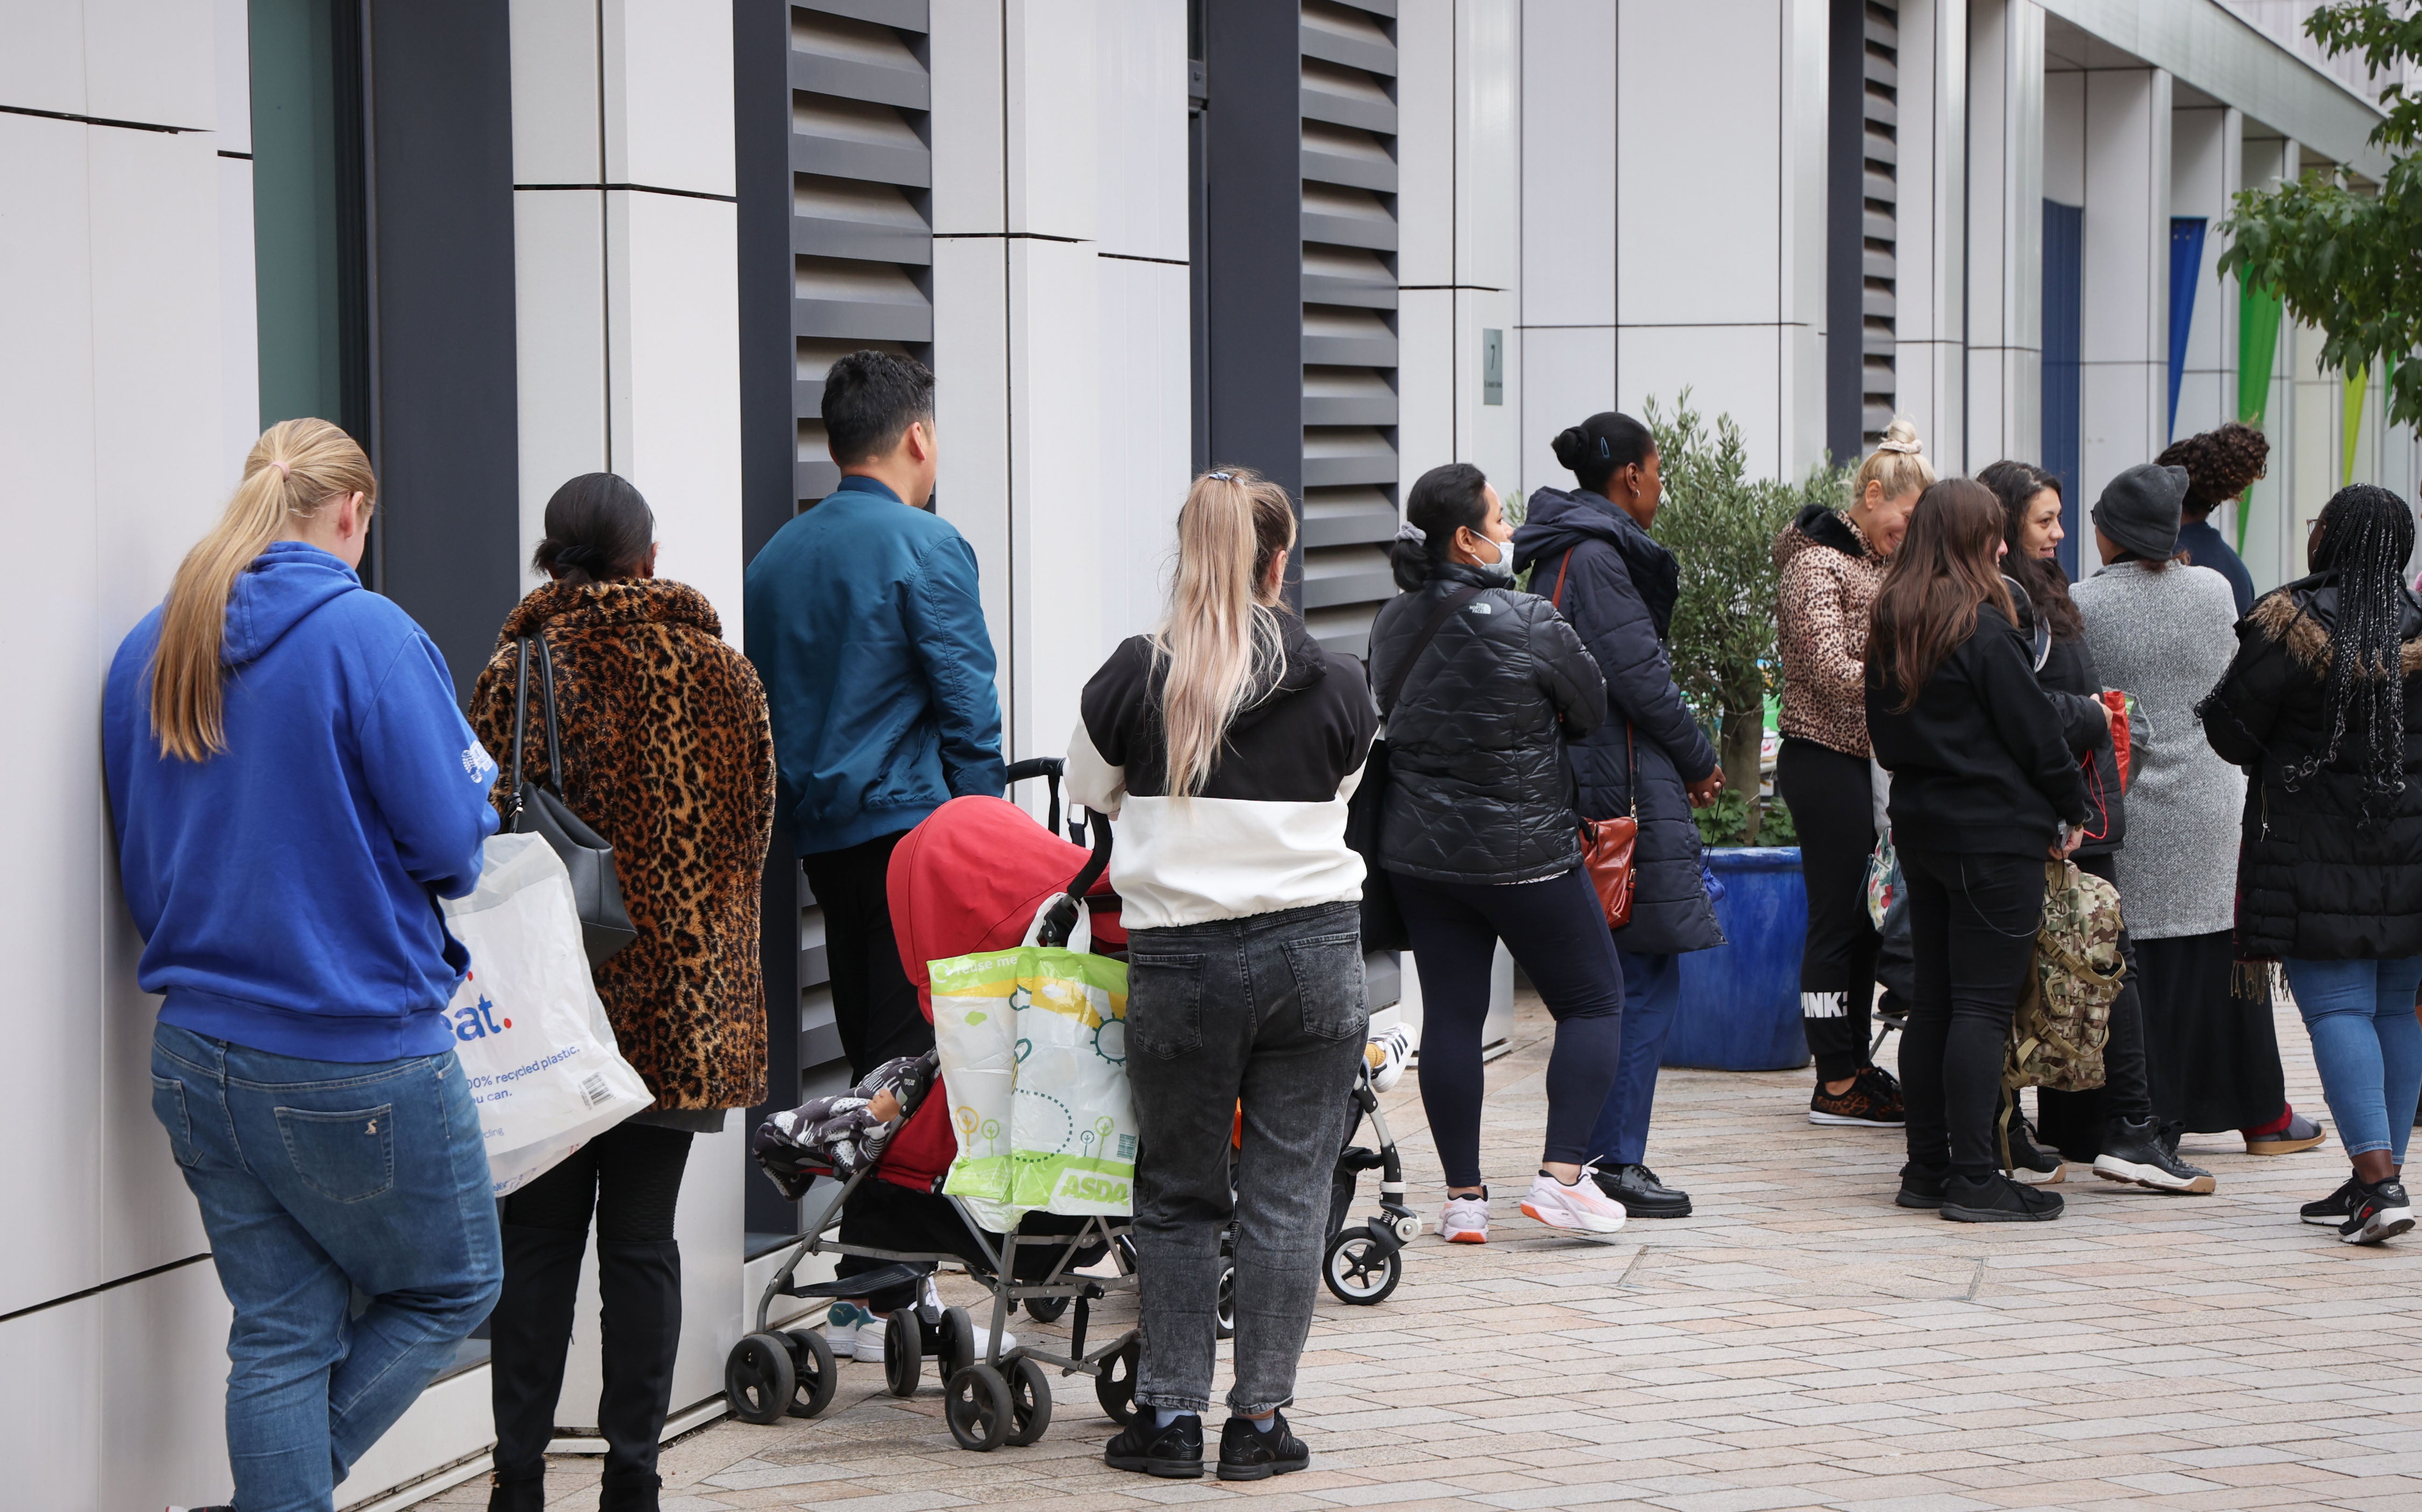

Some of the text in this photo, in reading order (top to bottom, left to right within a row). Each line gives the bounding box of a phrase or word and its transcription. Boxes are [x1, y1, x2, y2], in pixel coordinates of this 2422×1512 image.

[1491, 344, 1496, 370] 7
[956, 956, 1018, 975] reuse me
[496, 1061, 540, 1084] recycled
[541, 1045, 580, 1070] plastic.
[487, 1090, 513, 1101] can.
[1059, 1175, 1129, 1206] ASDA
